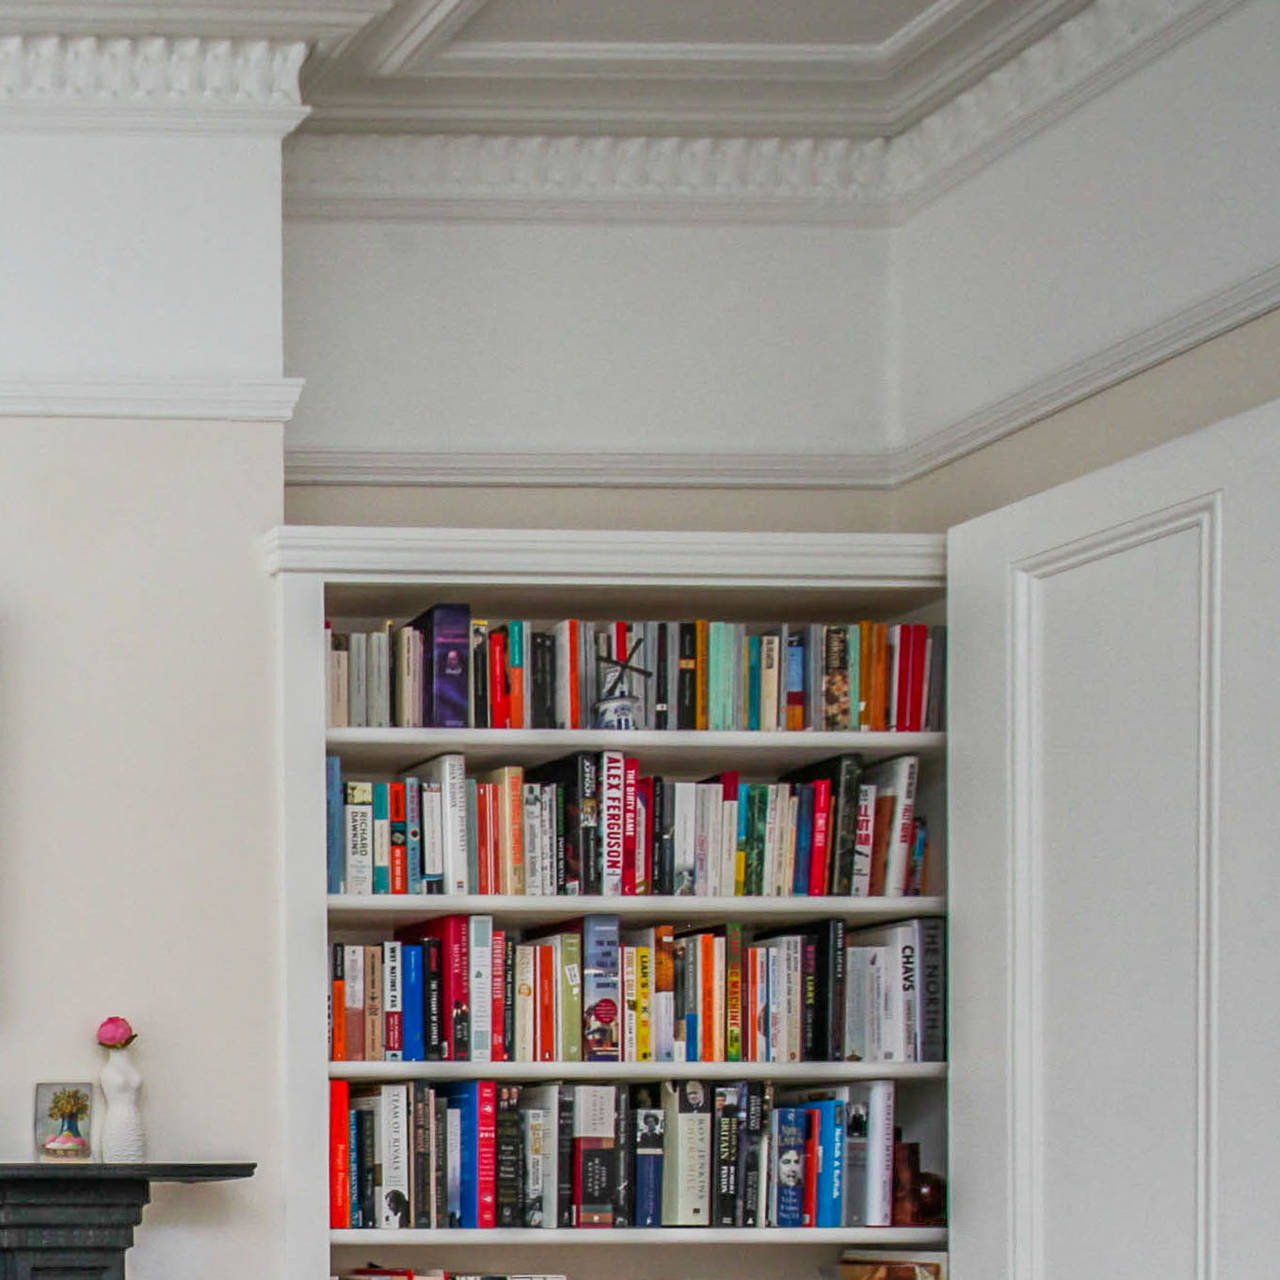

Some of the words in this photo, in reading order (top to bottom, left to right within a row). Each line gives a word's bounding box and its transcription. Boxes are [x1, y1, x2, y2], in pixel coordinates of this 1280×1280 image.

[607, 757, 621, 792] ALEX
[625, 770, 635, 785] THE
[625, 787, 635, 811] DIRTY
[351, 811, 359, 856] DAWKINS
[359, 811, 368, 857] RICHARD
[607, 797, 621, 870] FERGUSON
[625, 813, 635, 837] GAME
[389, 946, 397, 963] WHY
[493, 936, 505, 976] ECONOMICS
[926, 923, 940, 956] THE
[389, 966, 397, 992] NATIONS
[641, 955, 649, 989] LIAR'S
[902, 946, 915, 992] CHAVS
[806, 976, 815, 1005] LIARS
[926, 965, 940, 1030] NORTH
[392, 1092, 401, 1119] TEAM
[392, 1121, 401, 1133] OF
[720, 1117, 729, 1160] BRITAIN
[392, 1137, 401, 1171] RIVALS
